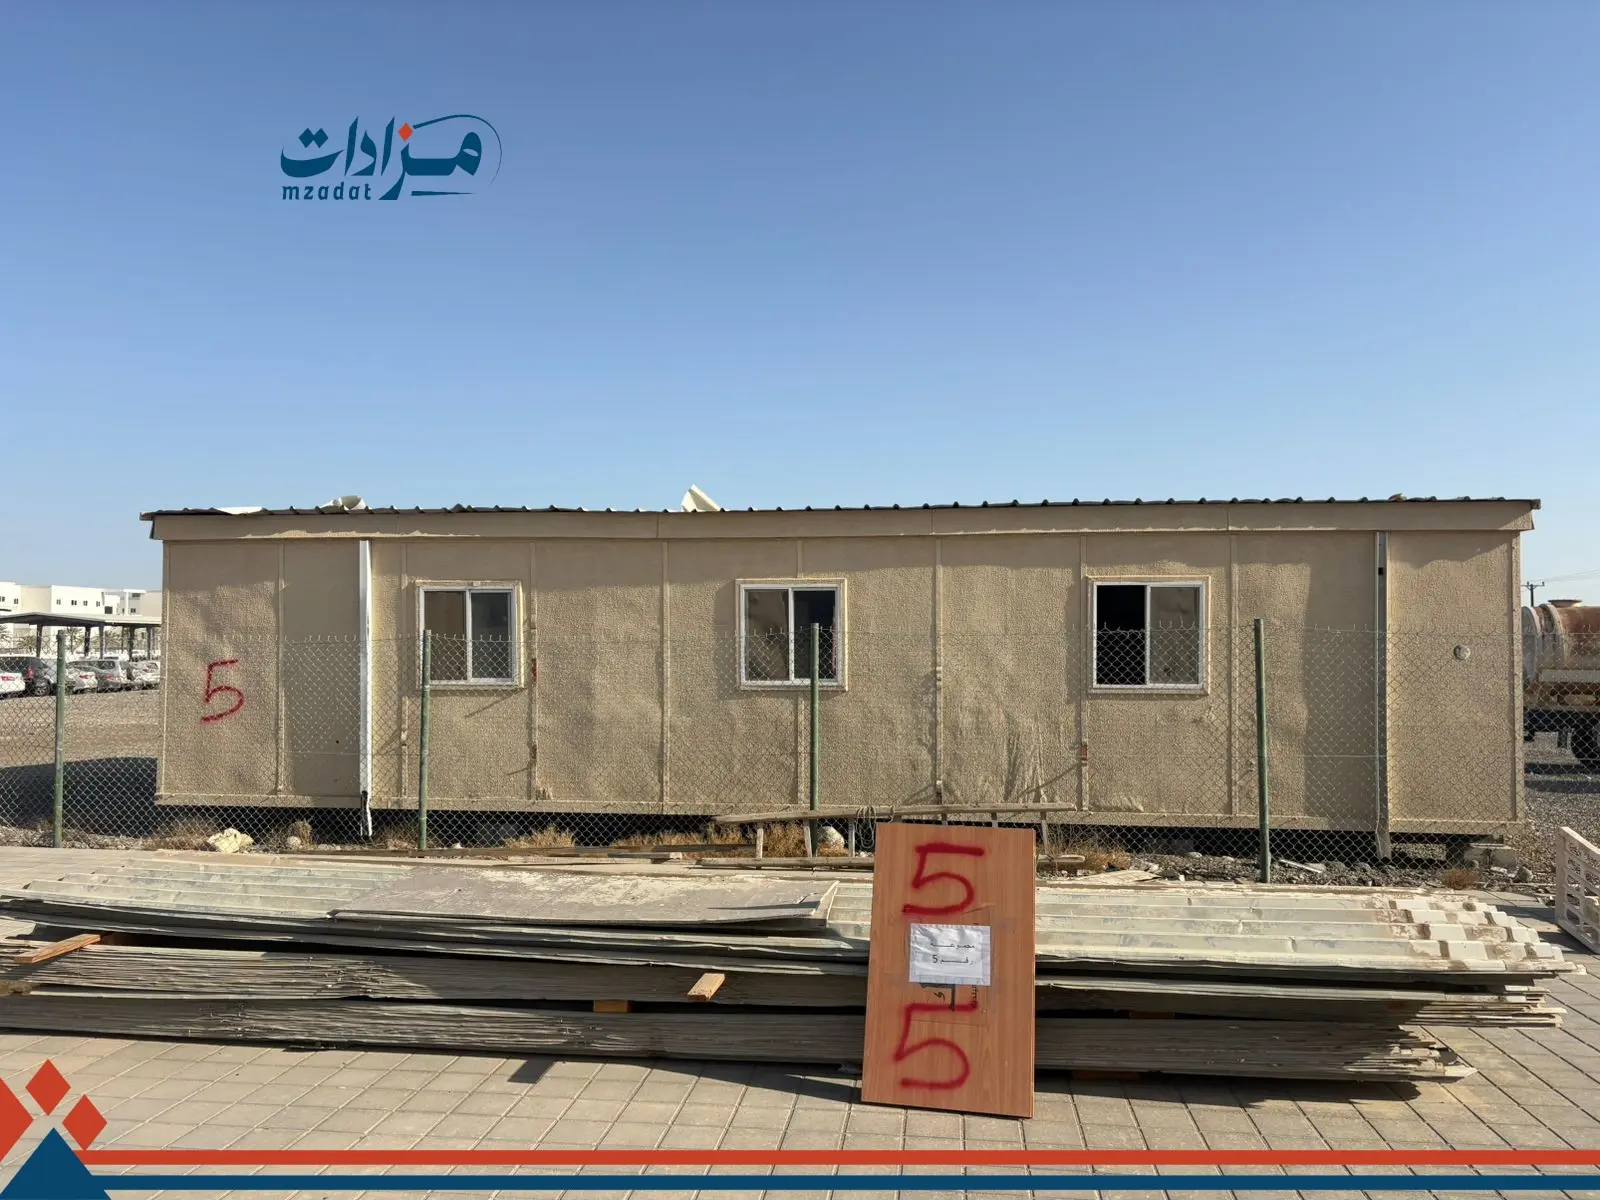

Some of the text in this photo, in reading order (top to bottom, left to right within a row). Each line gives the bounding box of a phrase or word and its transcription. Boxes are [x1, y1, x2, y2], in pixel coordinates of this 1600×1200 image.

[196, 659, 245, 723] 5
[901, 842, 986, 915] 5
[932, 954, 938, 964] 5
[893, 999, 979, 1089] 5
